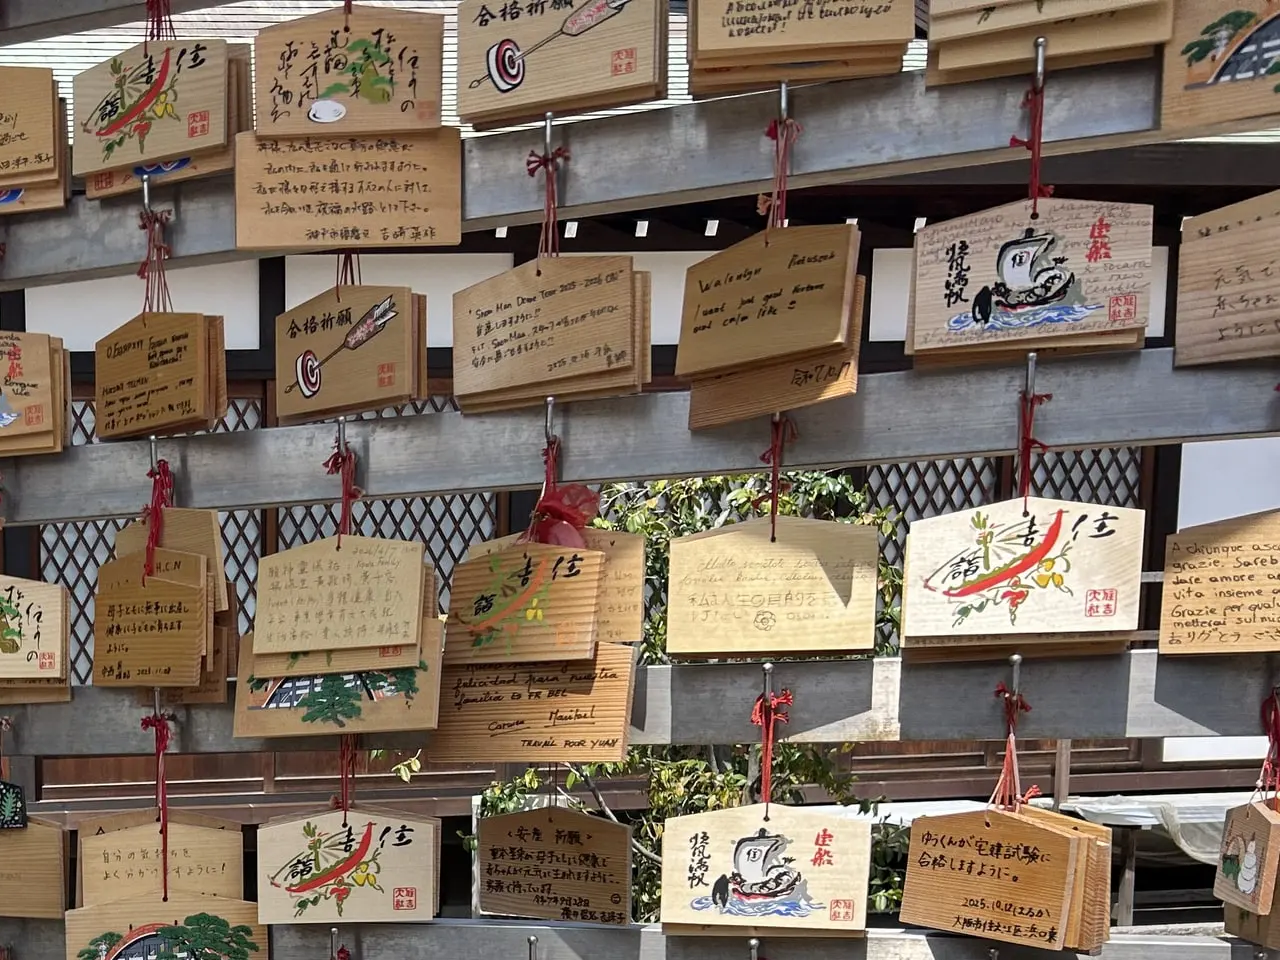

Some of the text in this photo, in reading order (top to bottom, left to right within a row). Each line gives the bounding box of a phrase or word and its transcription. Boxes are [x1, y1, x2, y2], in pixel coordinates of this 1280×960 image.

[286, 307, 353, 338] 合格祈願
[1172, 542, 1243, 558] A chiunque
[1172, 559, 1225, 574] grazie.
[1209, 573, 1255, 582] amore
[1173, 587, 1263, 600] vita insieme
[1171, 604, 1217, 618] Grazie
[921, 832, 1052, 865] ゆうくんが宅建試験に
[918, 850, 1019, 882] 合格しますように。
